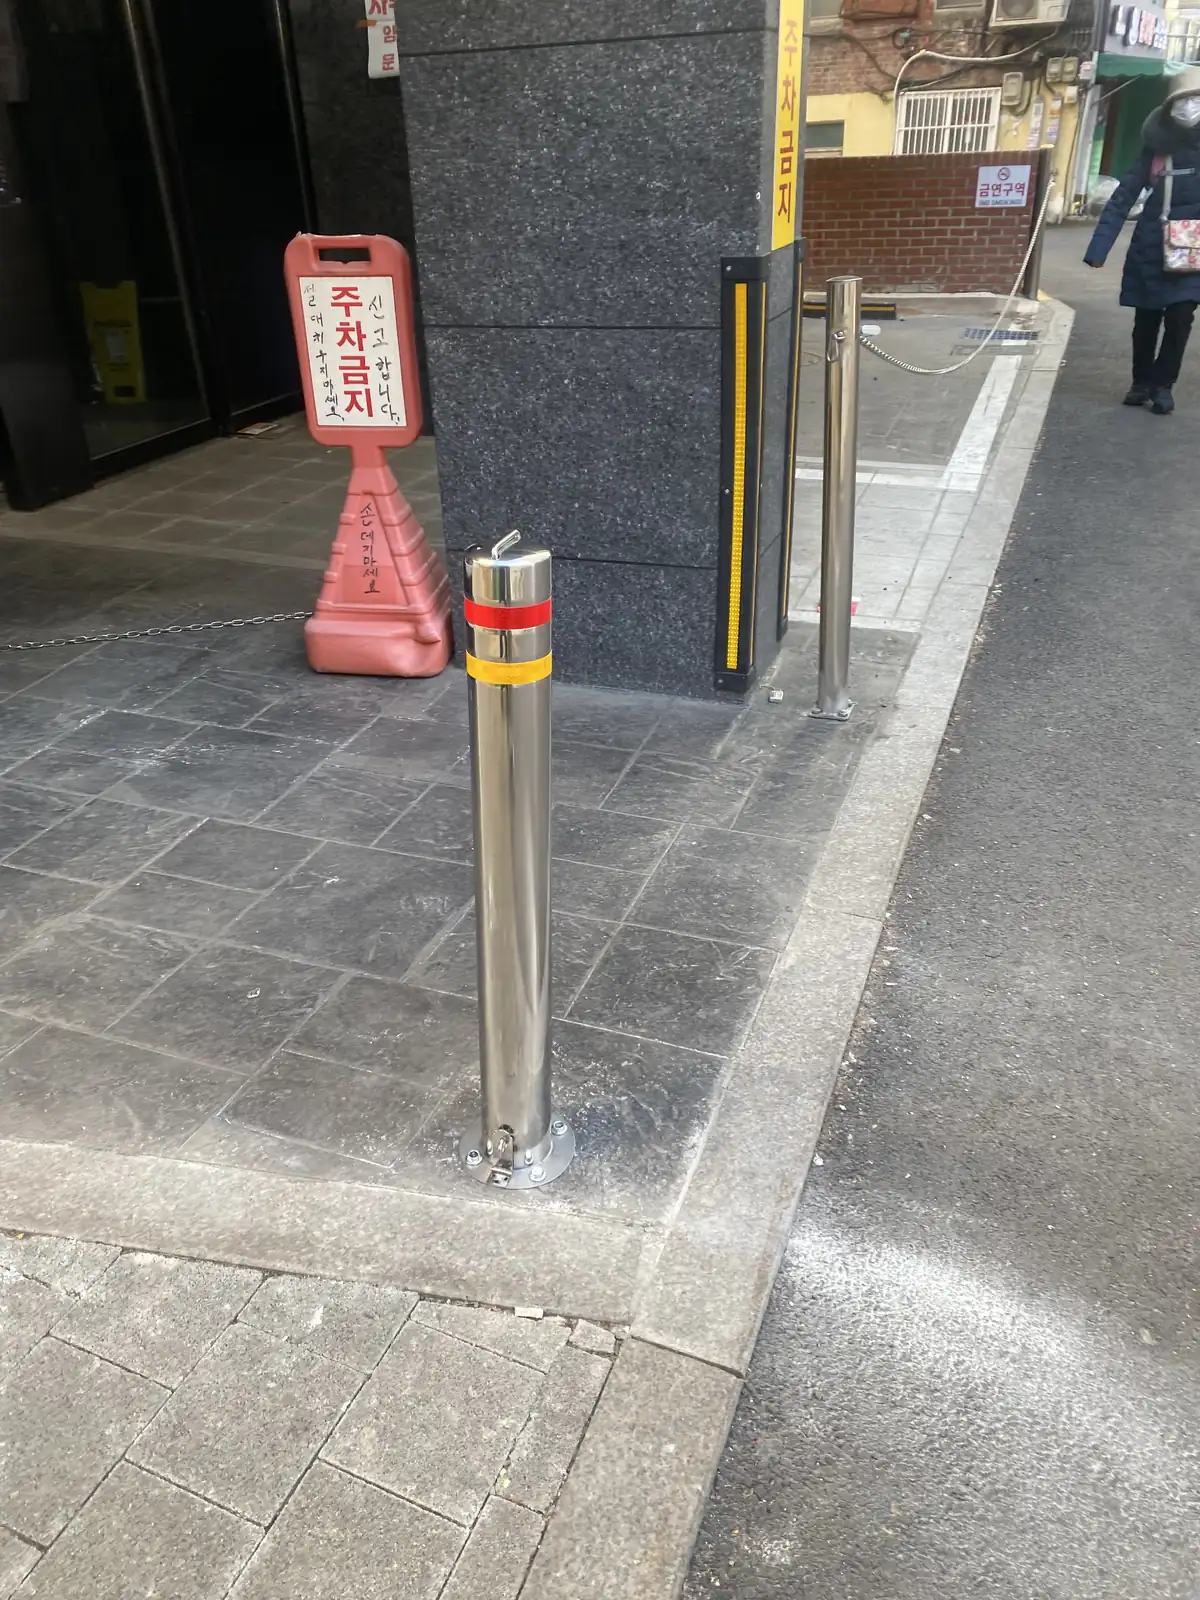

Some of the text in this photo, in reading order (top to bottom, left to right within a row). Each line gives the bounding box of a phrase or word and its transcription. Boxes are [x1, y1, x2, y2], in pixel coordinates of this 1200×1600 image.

[776, 19, 798, 224] 주차금지
[979, 182, 1026, 198] 금연구역
[330, 286, 374, 418] 주차금지
